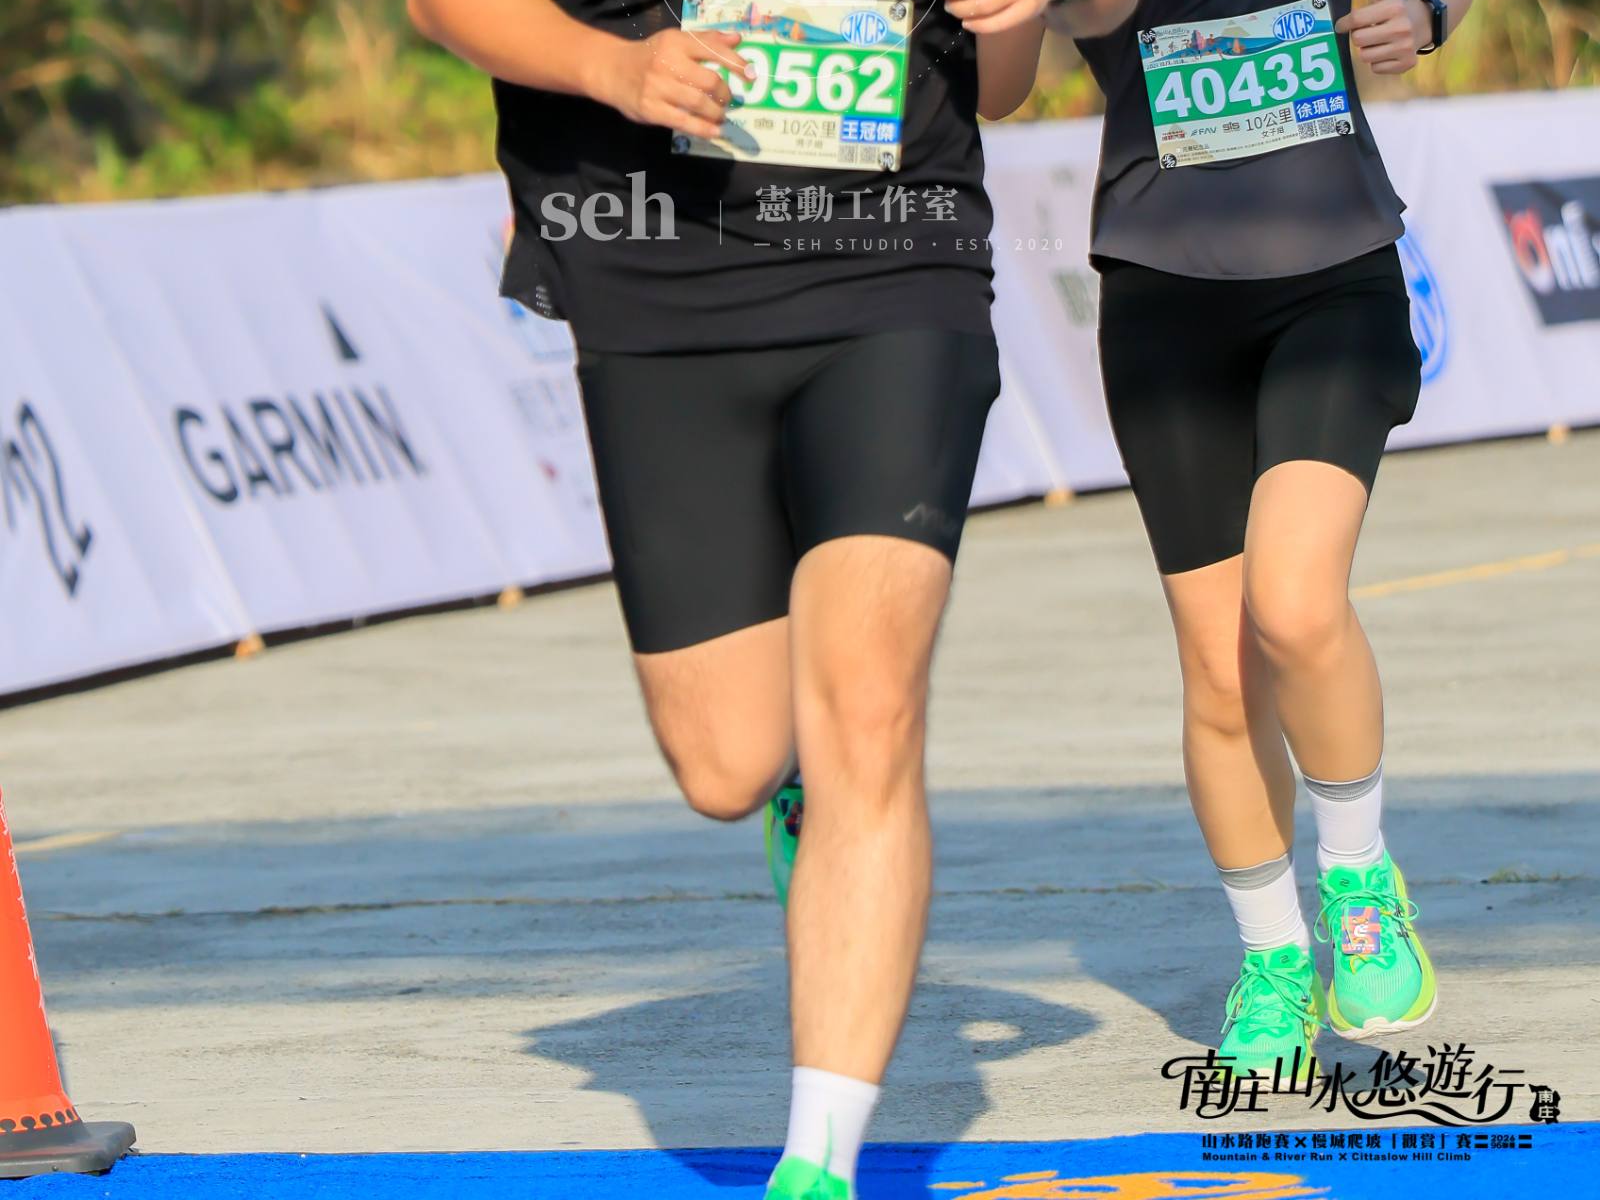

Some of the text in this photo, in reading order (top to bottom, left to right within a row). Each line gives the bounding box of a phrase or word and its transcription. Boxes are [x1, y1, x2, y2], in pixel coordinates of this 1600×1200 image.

[700, 47, 896, 113] 0562
[1154, 42, 1336, 118] 40435
[782, 118, 836, 138] 10公里
[842, 119, 895, 142] 王冠傑
[1246, 107, 1293, 132] 10公里
[174, 388, 428, 503] GARMIN
